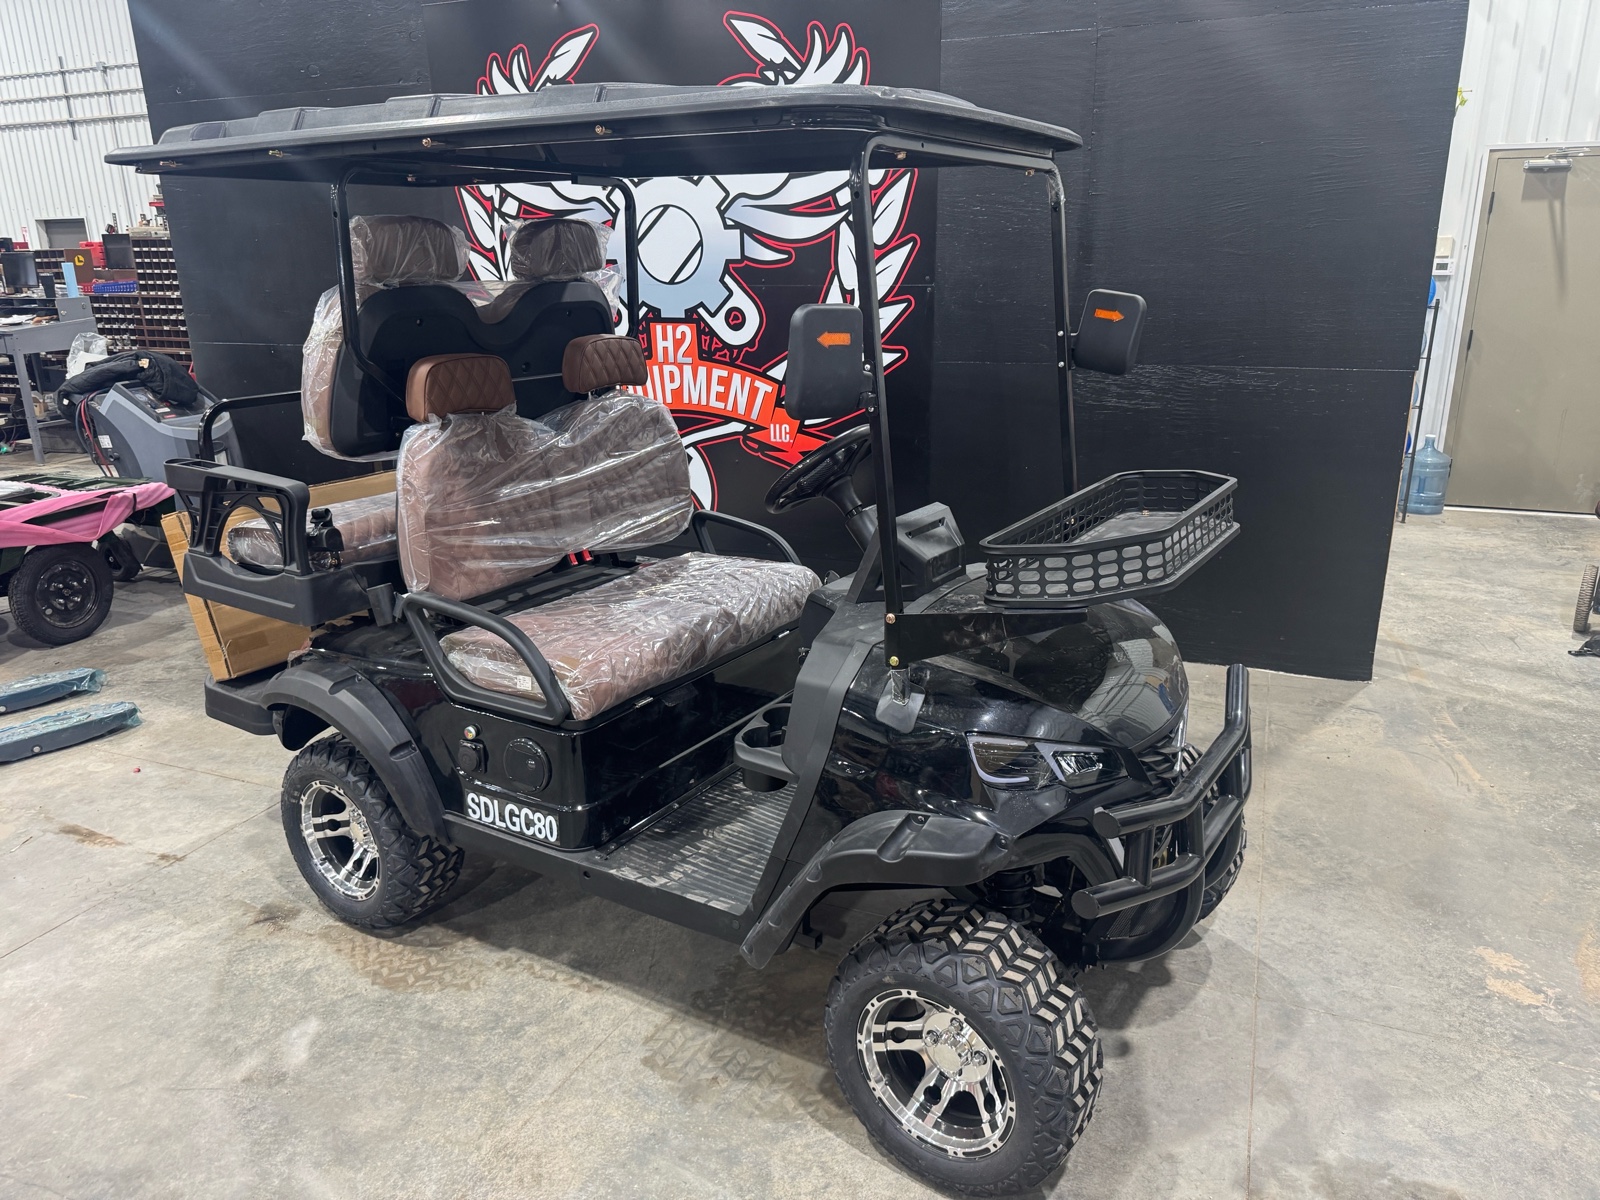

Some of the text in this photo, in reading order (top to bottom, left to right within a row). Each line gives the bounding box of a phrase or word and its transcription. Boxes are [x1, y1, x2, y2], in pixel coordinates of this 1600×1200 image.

[655, 324, 693, 364] H2
[628, 364, 773, 421] IPMENT
[769, 423, 794, 443] LLC.
[466, 792, 558, 842] SDLGC80
